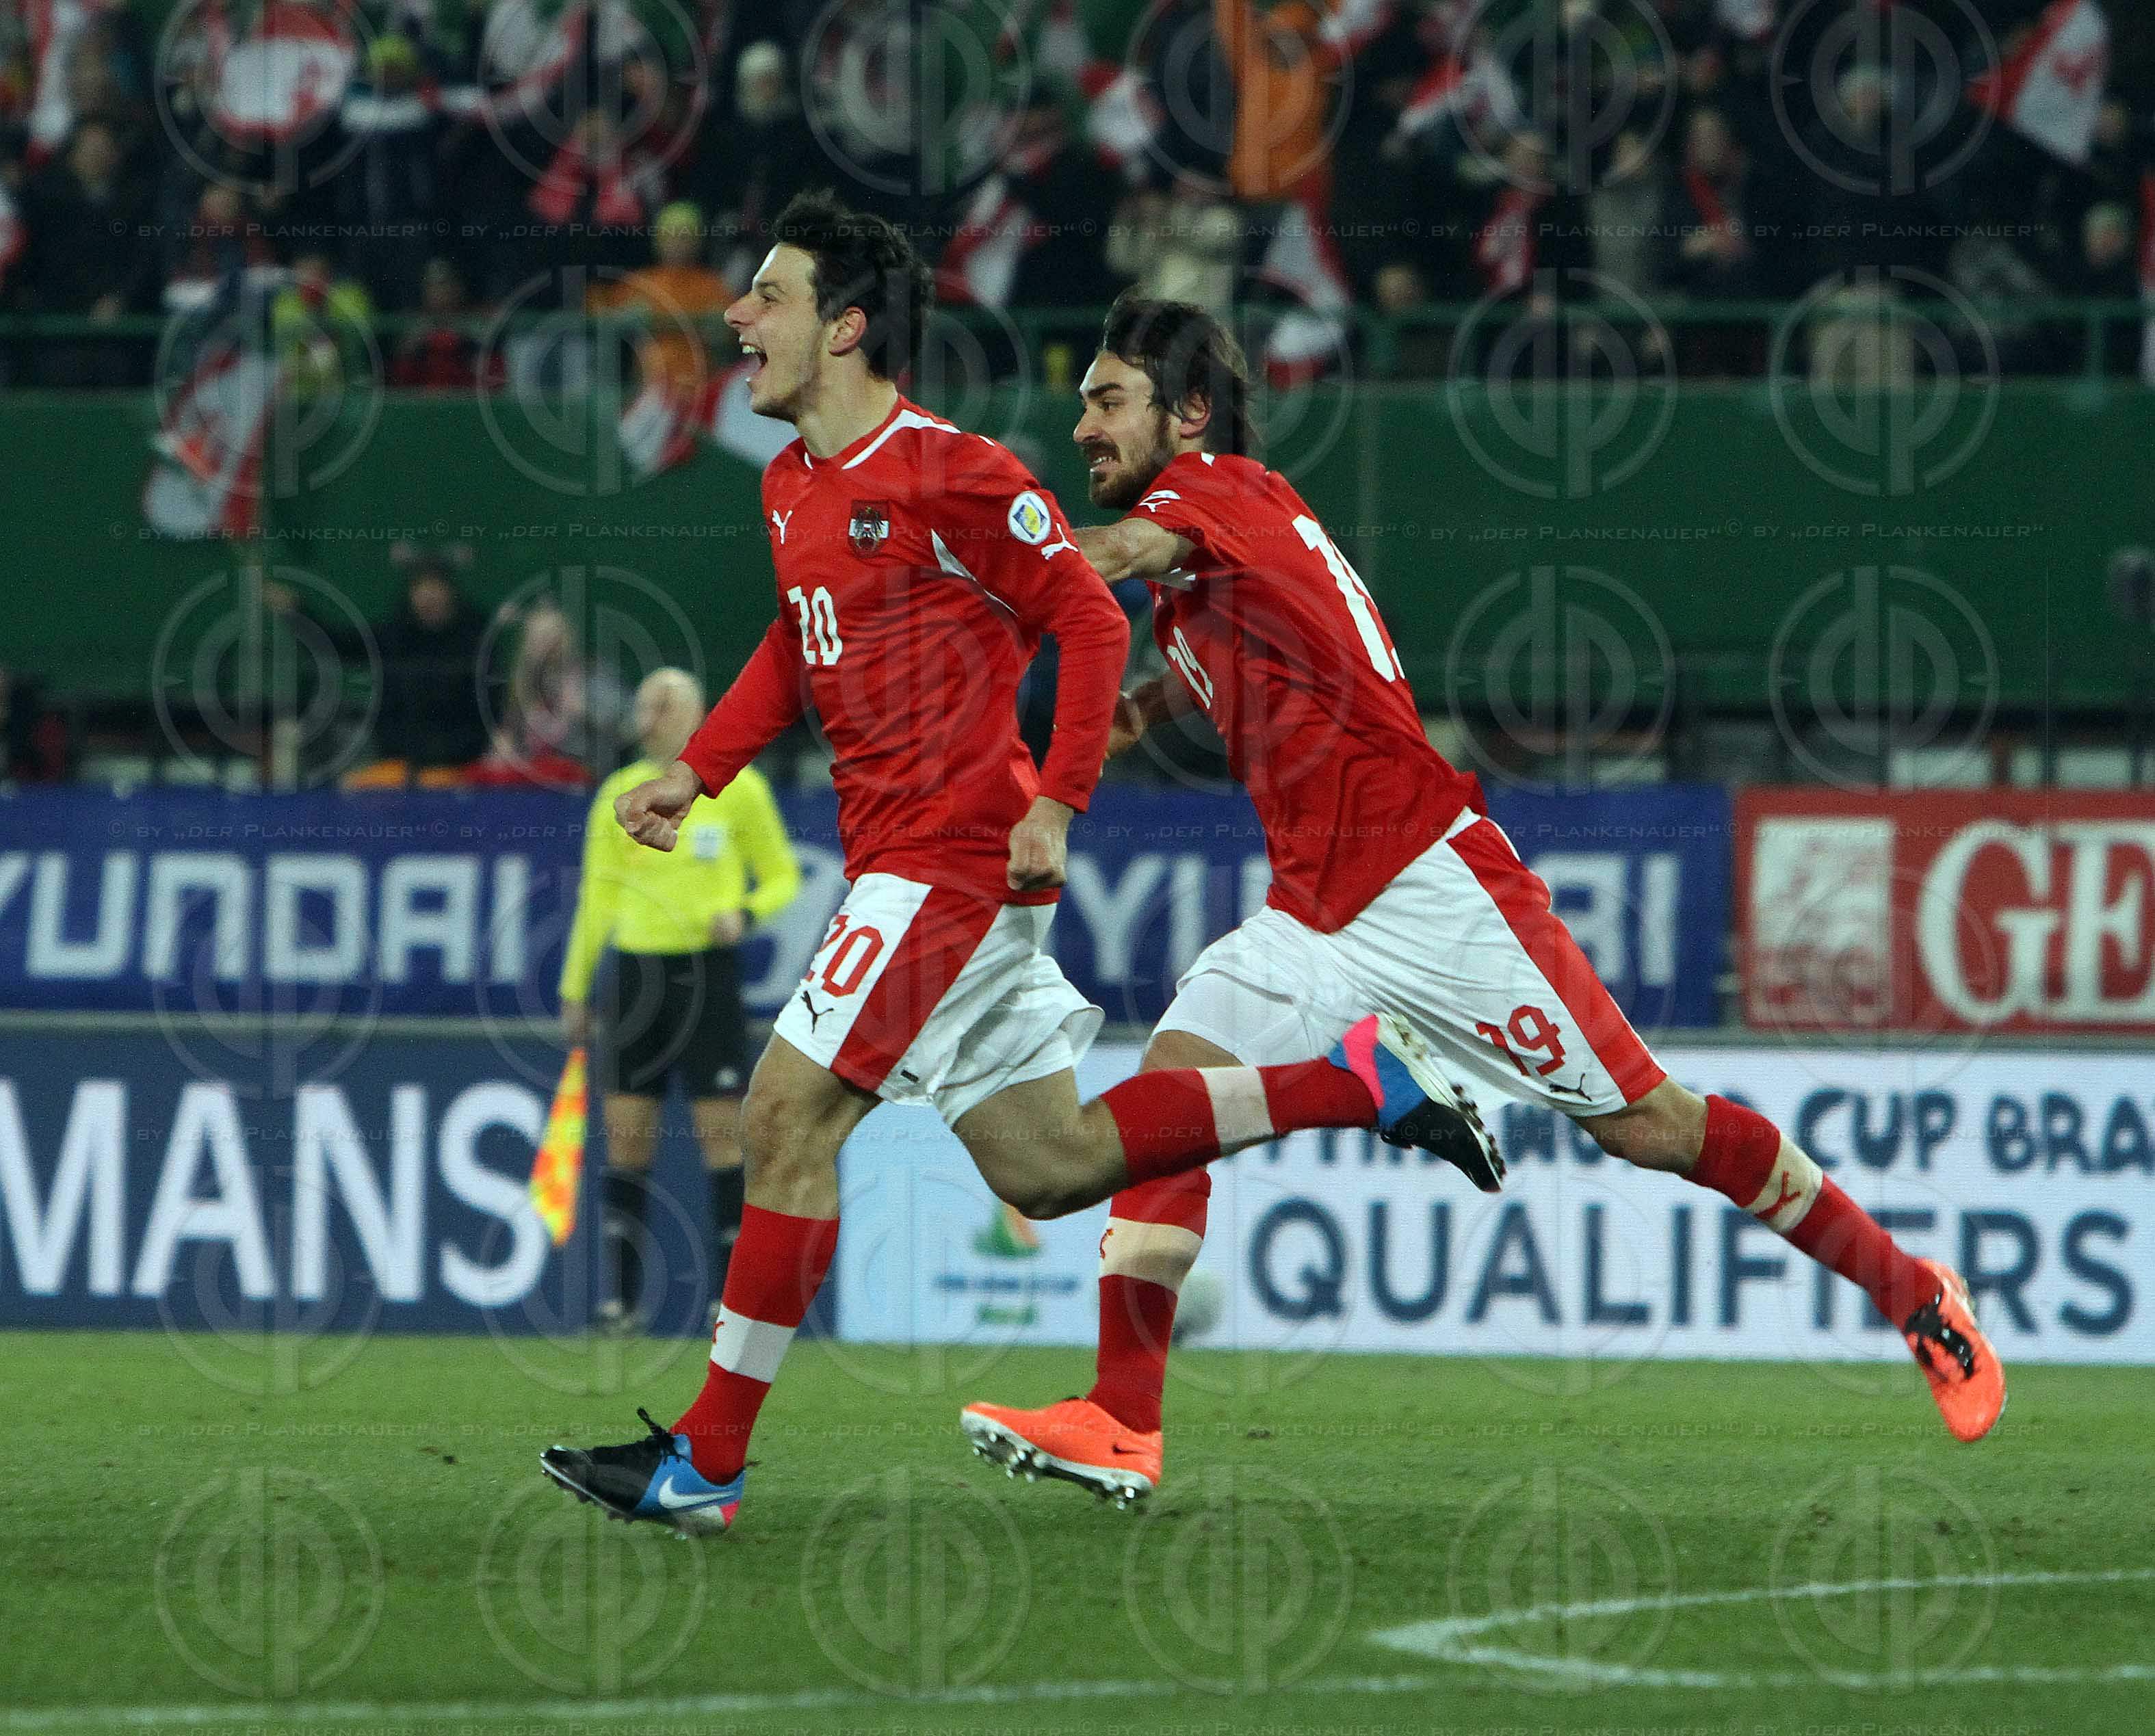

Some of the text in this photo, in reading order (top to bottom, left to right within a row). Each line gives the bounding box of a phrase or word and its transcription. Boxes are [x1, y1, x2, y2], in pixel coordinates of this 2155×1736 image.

[787, 586, 843, 666] 10
[0, 852, 532, 984] UNDAI
[1918, 818, 2155, 1025] GE
[1475, 1005, 1565, 1077] 19
[1795, 1088, 1957, 1168] CUP
